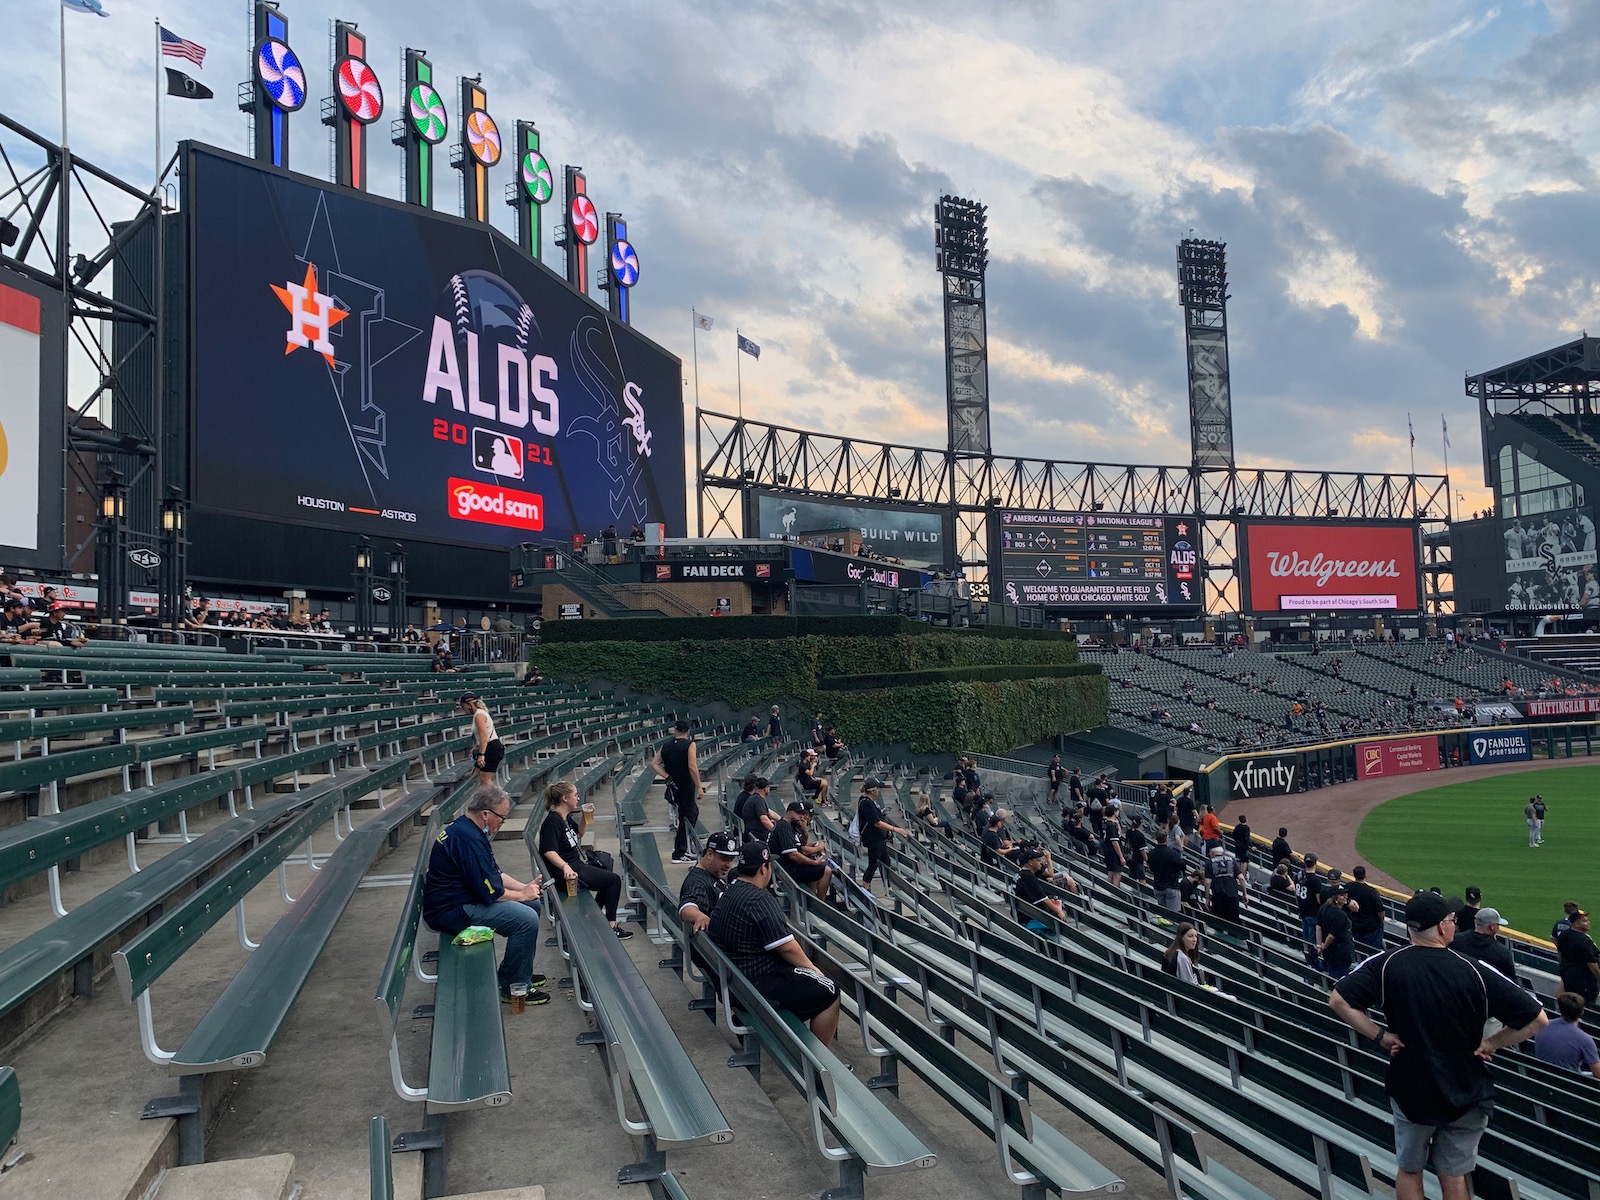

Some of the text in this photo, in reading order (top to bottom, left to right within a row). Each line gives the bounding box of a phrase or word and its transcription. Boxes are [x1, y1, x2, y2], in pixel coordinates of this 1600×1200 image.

[422, 314, 560, 437] ALDS
[1199, 424, 1227, 432] WHITE
[432, 418, 553, 466] 20 21
[1199, 432, 1227, 444] SOX
[297, 495, 417, 523] HOUSTON ASTROS
[457, 491, 539, 521] good sam
[1012, 514, 1075, 524] AMERICAN LEAGUE
[1096, 517, 1153, 526] NATIONAL LEAGUE
[860, 526, 899, 541] BUILT
[1170, 550, 1197, 565] ALDS
[683, 565, 744, 577] FAN DECK
[1266, 550, 1401, 588] Walgreens
[969, 583, 990, 596] 5:29
[1022, 585, 1058, 594] WELCOME
[1070, 585, 1115, 594] GUARANTEED
[1115, 586, 1132, 594] RATE
[1133, 586, 1151, 594] FIELD
[1026, 593, 1148, 602] HOME OF YOUR CHICAGO WHITE SOX
[1338, 598, 1362, 606] Chicago's
[1504, 603, 1527, 611] GOOSE
[1553, 603, 1570, 611] BEER
[1530, 700, 1586, 715] WHITTINGHAM
[1488, 736, 1526, 749] FANDUEL
[1389, 744, 1422, 753] Commercial Banking
[1488, 747, 1527, 757] SPORTSBOOK
[1365, 749, 1380, 760] CIBC
[1396, 753, 1408, 761] Capital
[1411, 759, 1423, 767] Wealth
[1232, 760, 1295, 798] xfinity
[241, 1055, 252, 1065] 20
[492, 1096, 502, 1105] 19
[716, 1133, 726, 1142] 18
[921, 1158, 931, 1167] 17
[1111, 1183, 1120, 1192] 16
